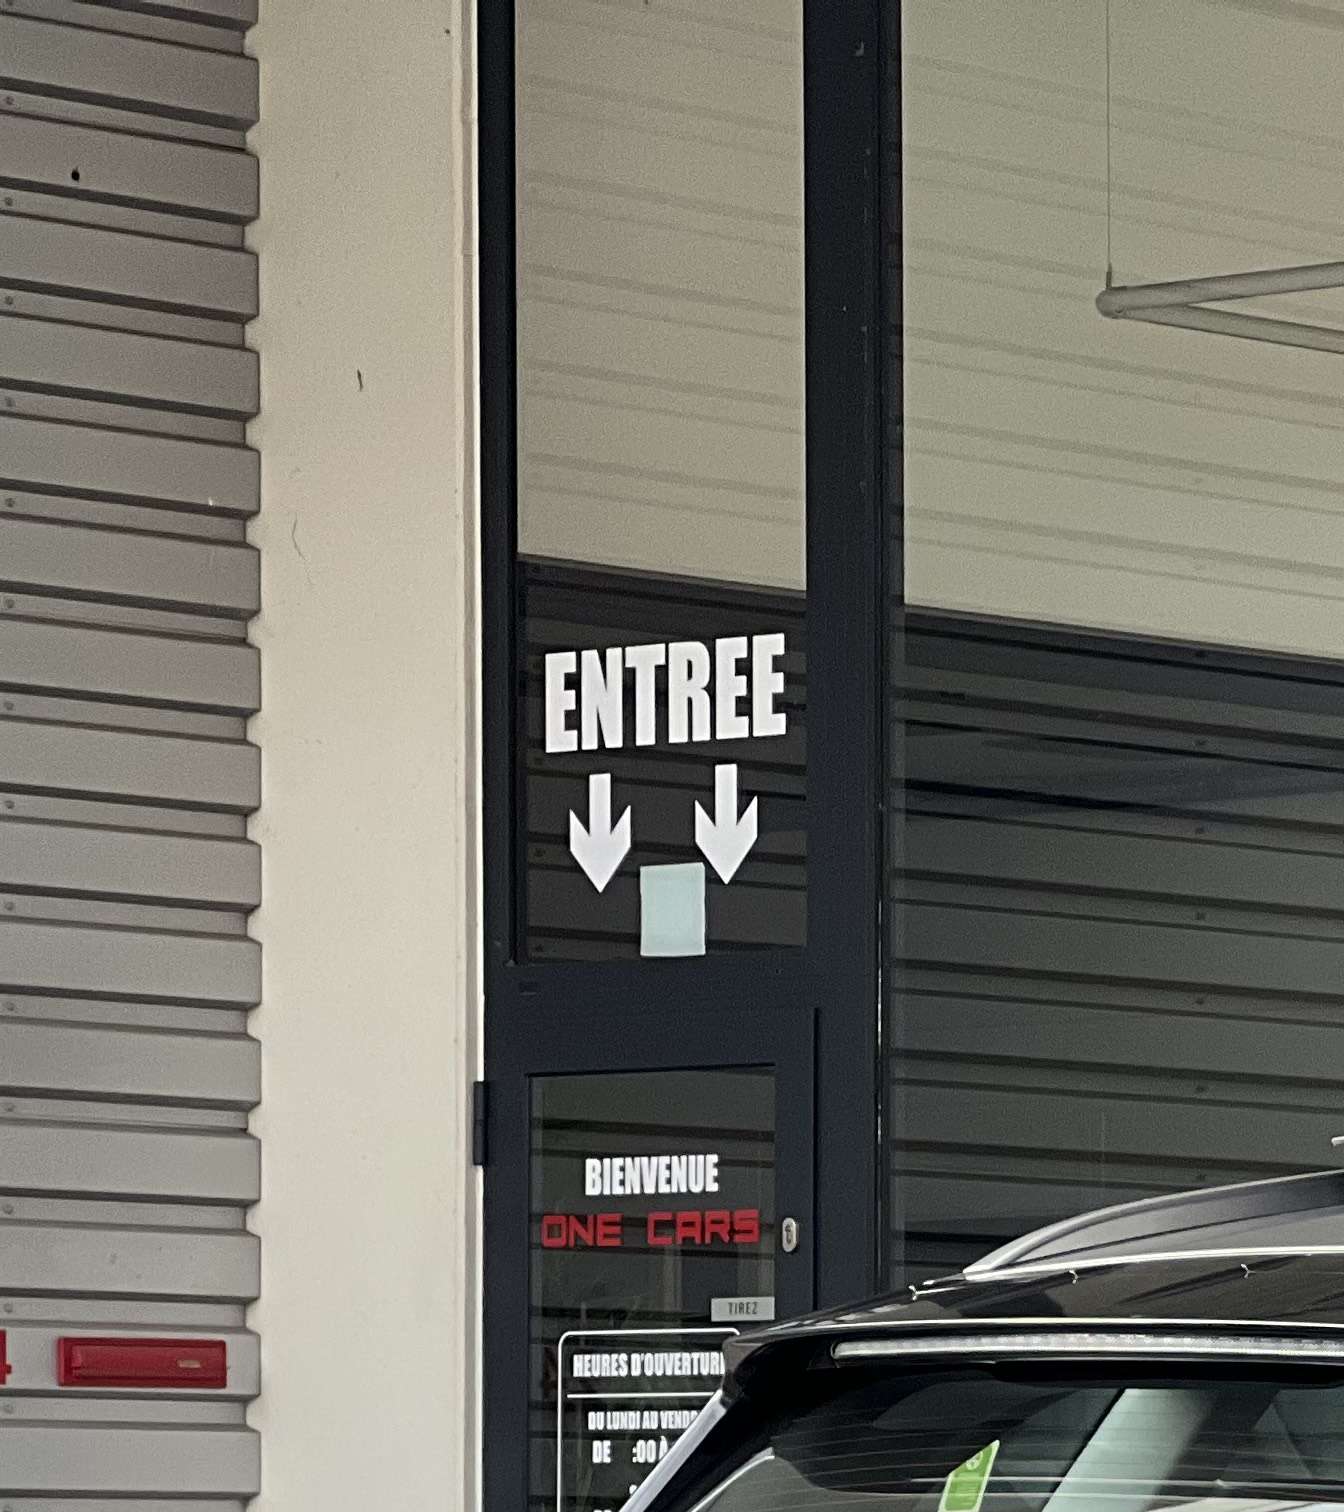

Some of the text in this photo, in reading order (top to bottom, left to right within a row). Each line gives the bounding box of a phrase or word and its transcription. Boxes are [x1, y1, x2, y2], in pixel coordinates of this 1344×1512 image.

[544, 632, 786, 754] ENTREE
[585, 1154, 719, 1196] BIENVENUE
[542, 1208, 760, 1249] ONE CARS
[727, 1301, 759, 1316] TIREZ
[572, 1353, 629, 1378] HEURES
[588, 1411, 605, 1431] DU
[606, 1411, 641, 1430] LUNDI
[642, 1410, 659, 1430] AU
[592, 1440, 611, 1463] DE
